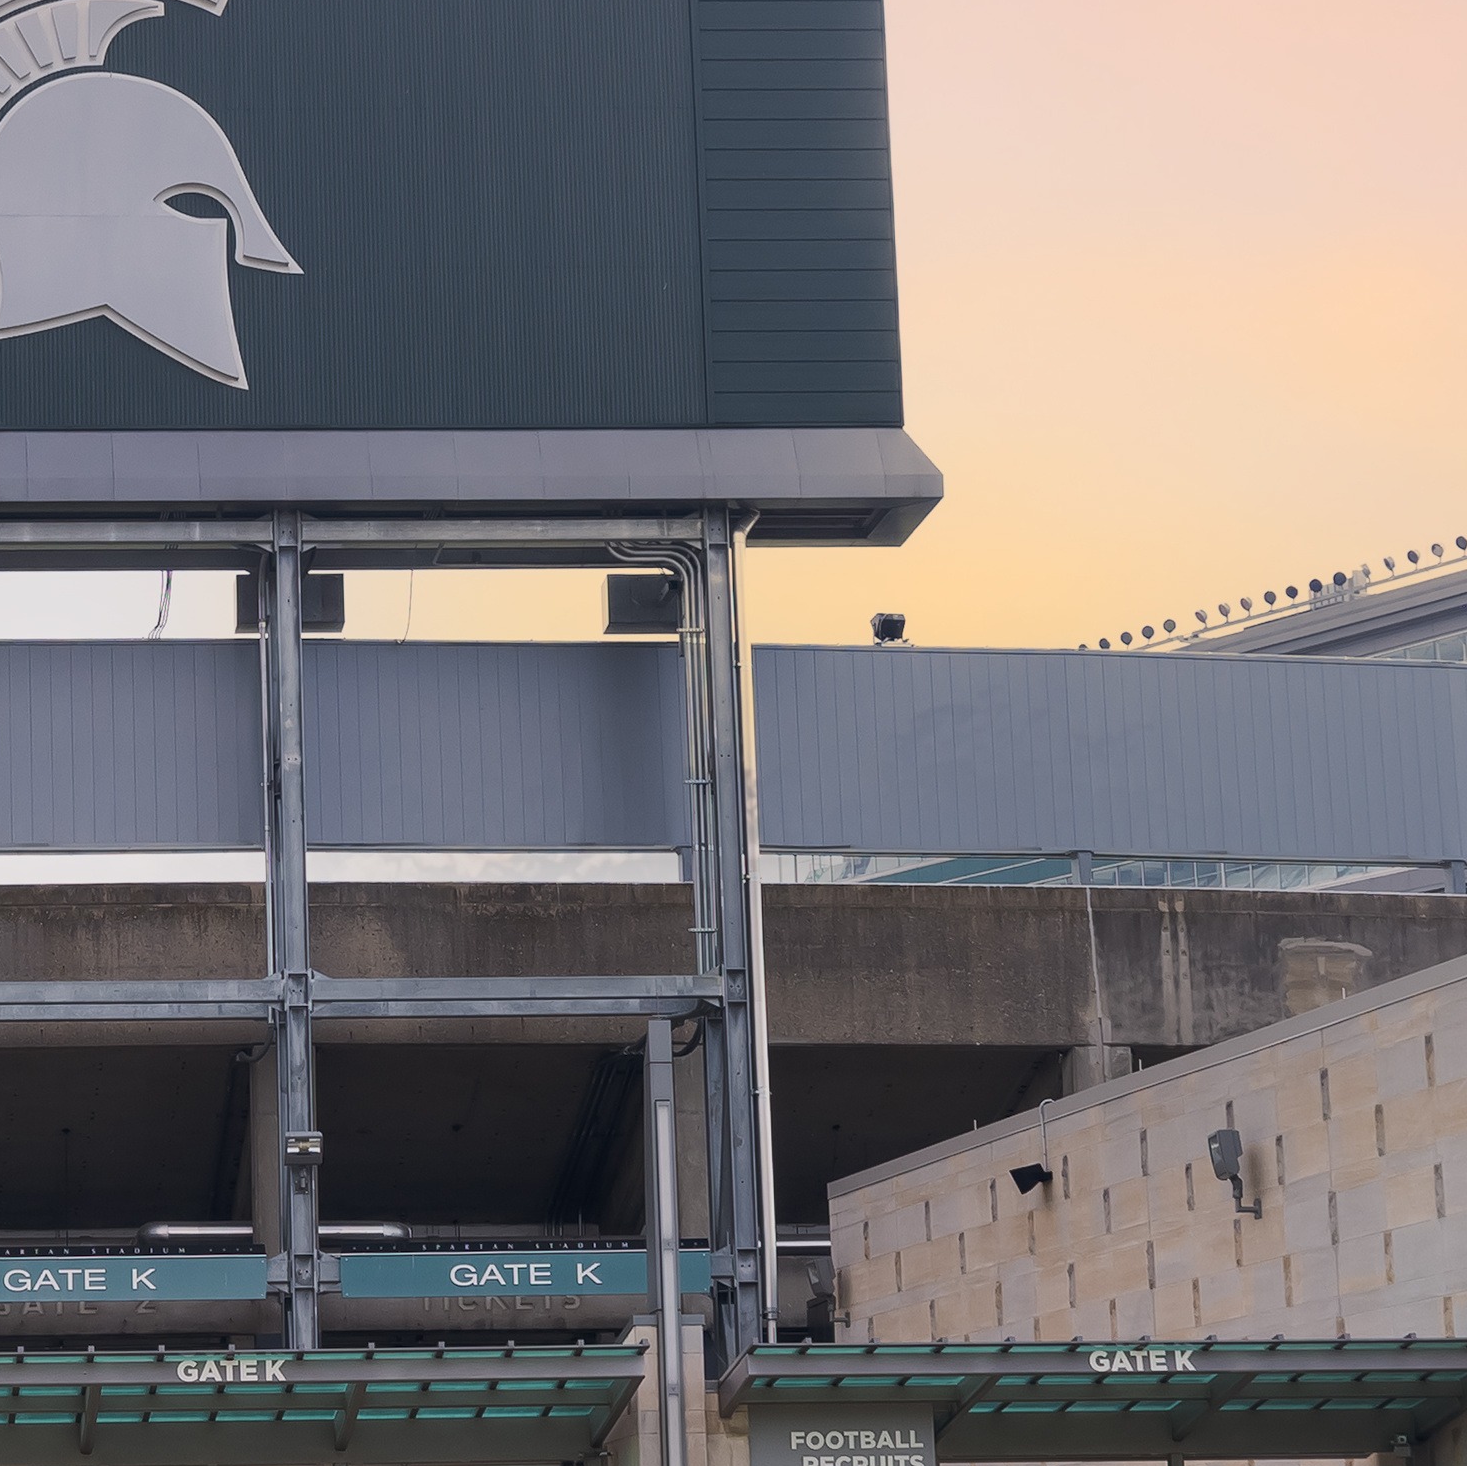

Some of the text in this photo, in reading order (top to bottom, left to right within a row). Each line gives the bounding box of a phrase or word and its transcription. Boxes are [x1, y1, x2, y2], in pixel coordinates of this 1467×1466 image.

[91, 1246, 187, 1255] STADIUM
[421, 1242, 631, 1251] SPARTAN STADIUM
[3, 1267, 157, 1292] GATE K
[448, 1261, 604, 1287] GATE K
[177, 1359, 286, 1383] GATE K
[1089, 1349, 1197, 1373] GATE K
[790, 1430, 924, 1450] FOOTBALL
